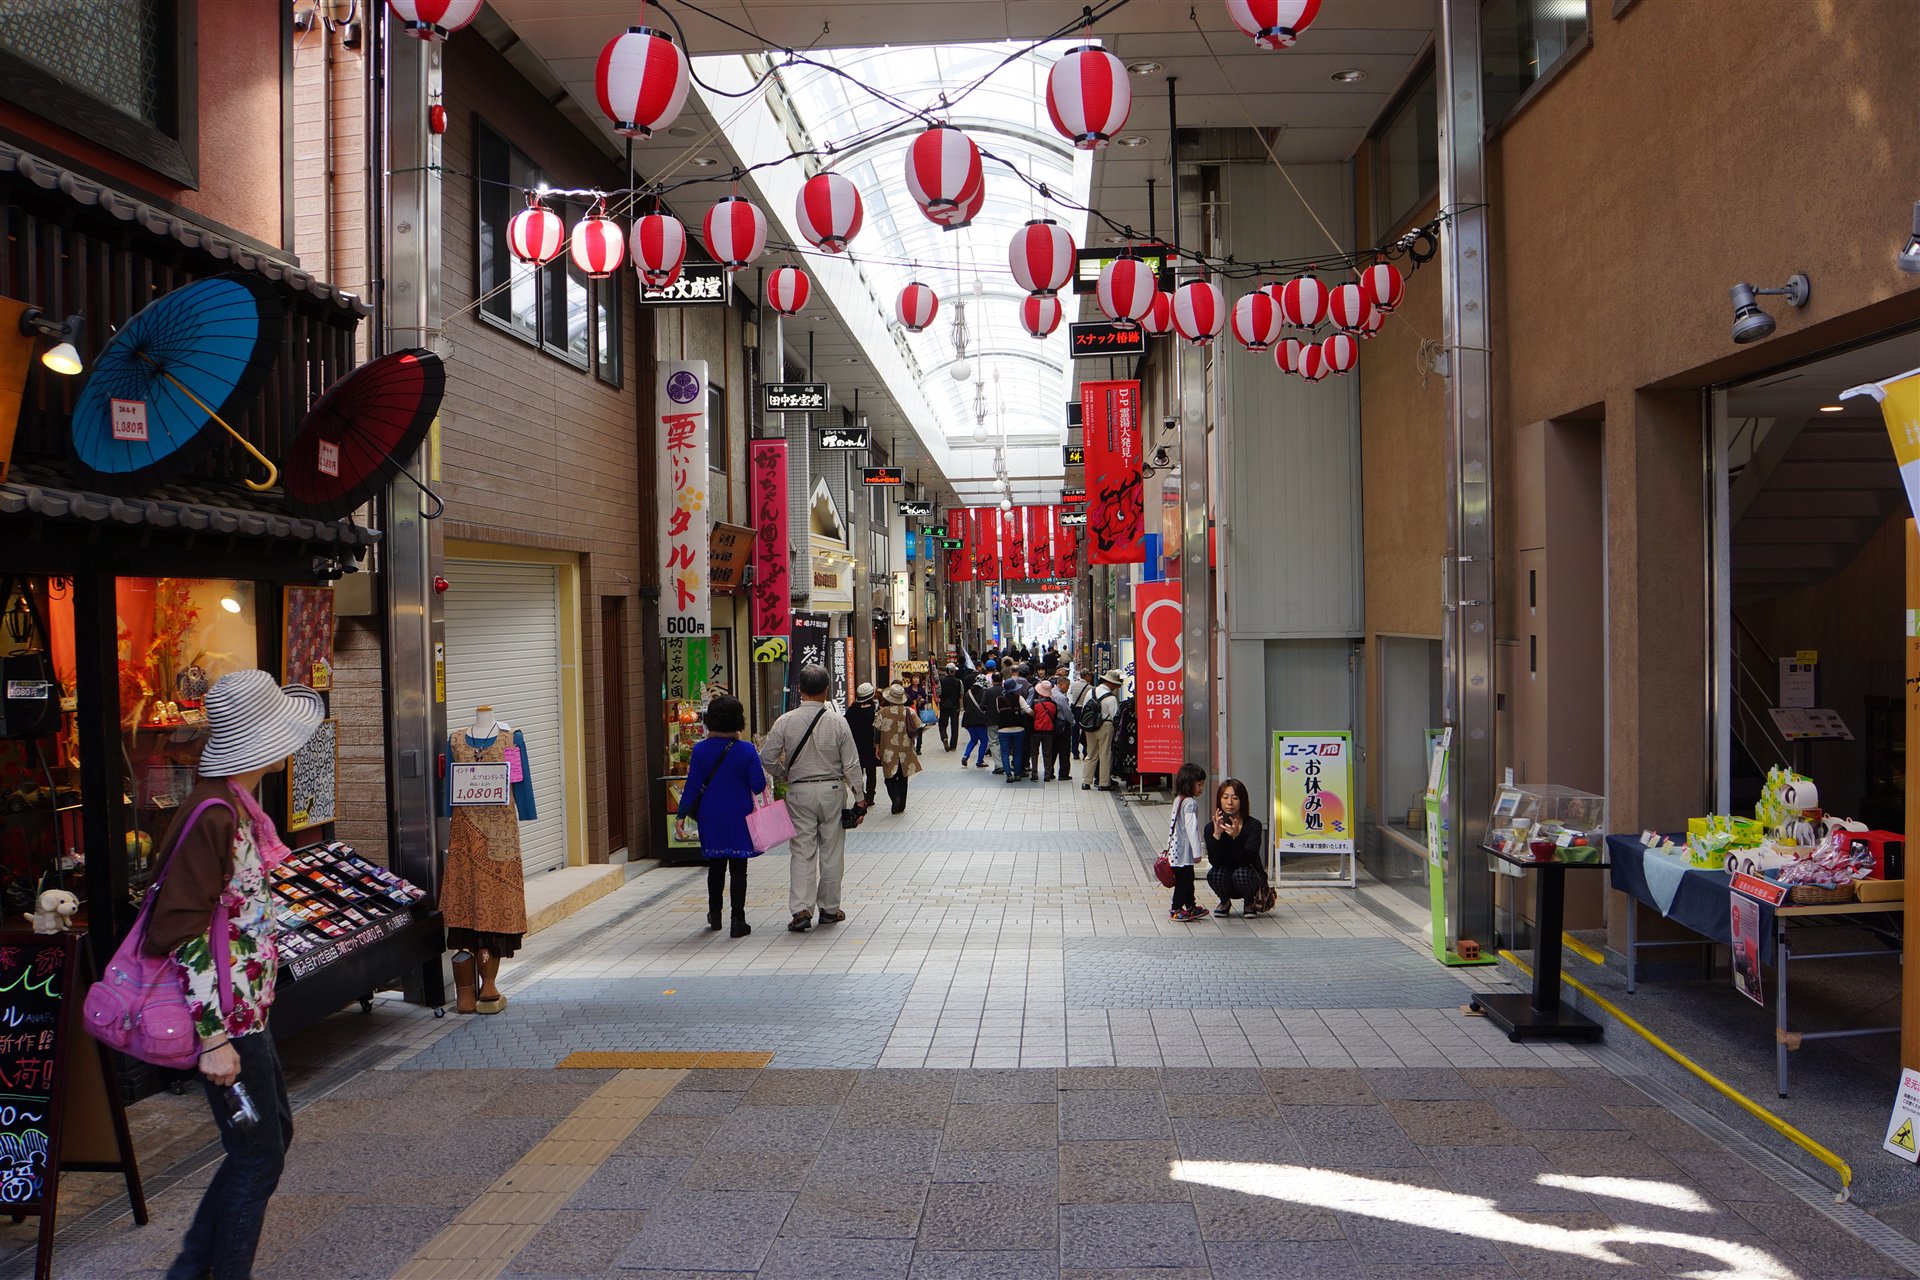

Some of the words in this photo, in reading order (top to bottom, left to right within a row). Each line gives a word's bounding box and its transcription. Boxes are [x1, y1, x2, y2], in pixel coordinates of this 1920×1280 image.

[115, 421, 144, 434] 1,080円
[456, 787, 503, 800] 1,080円
[1305, 759, 1323, 831] お休み処
